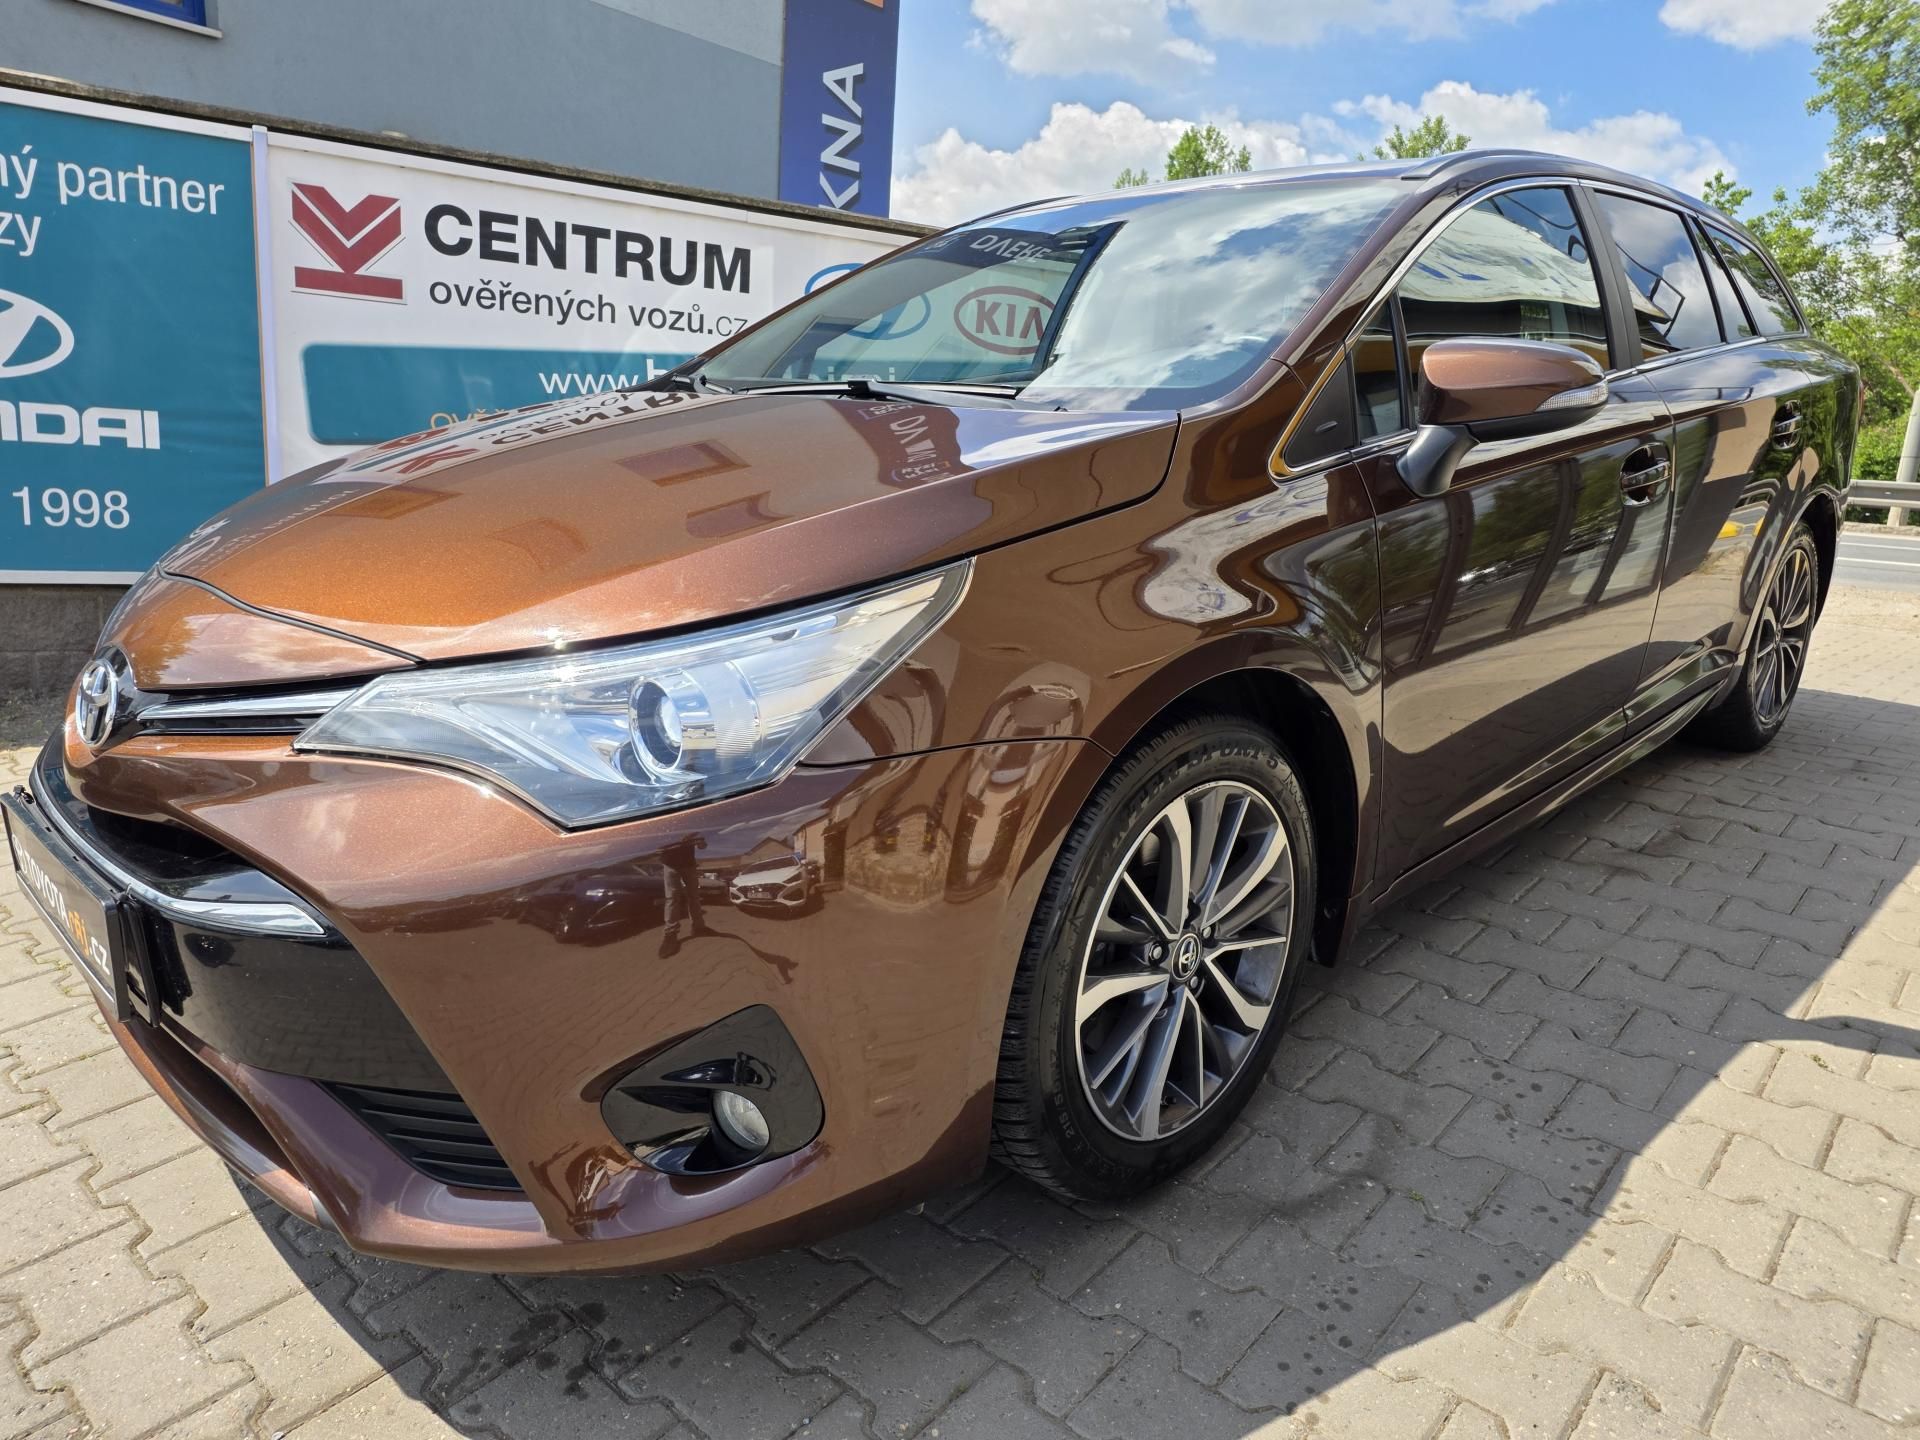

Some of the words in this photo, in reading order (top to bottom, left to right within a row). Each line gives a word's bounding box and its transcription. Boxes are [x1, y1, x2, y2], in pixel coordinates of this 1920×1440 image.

[57, 160, 225, 215] partner
[424, 203, 752, 294] CENTRUM
[429, 278, 617, 326] ověřených
[975, 299, 1045, 341] KIA
[12, 486, 130, 529] 1998
